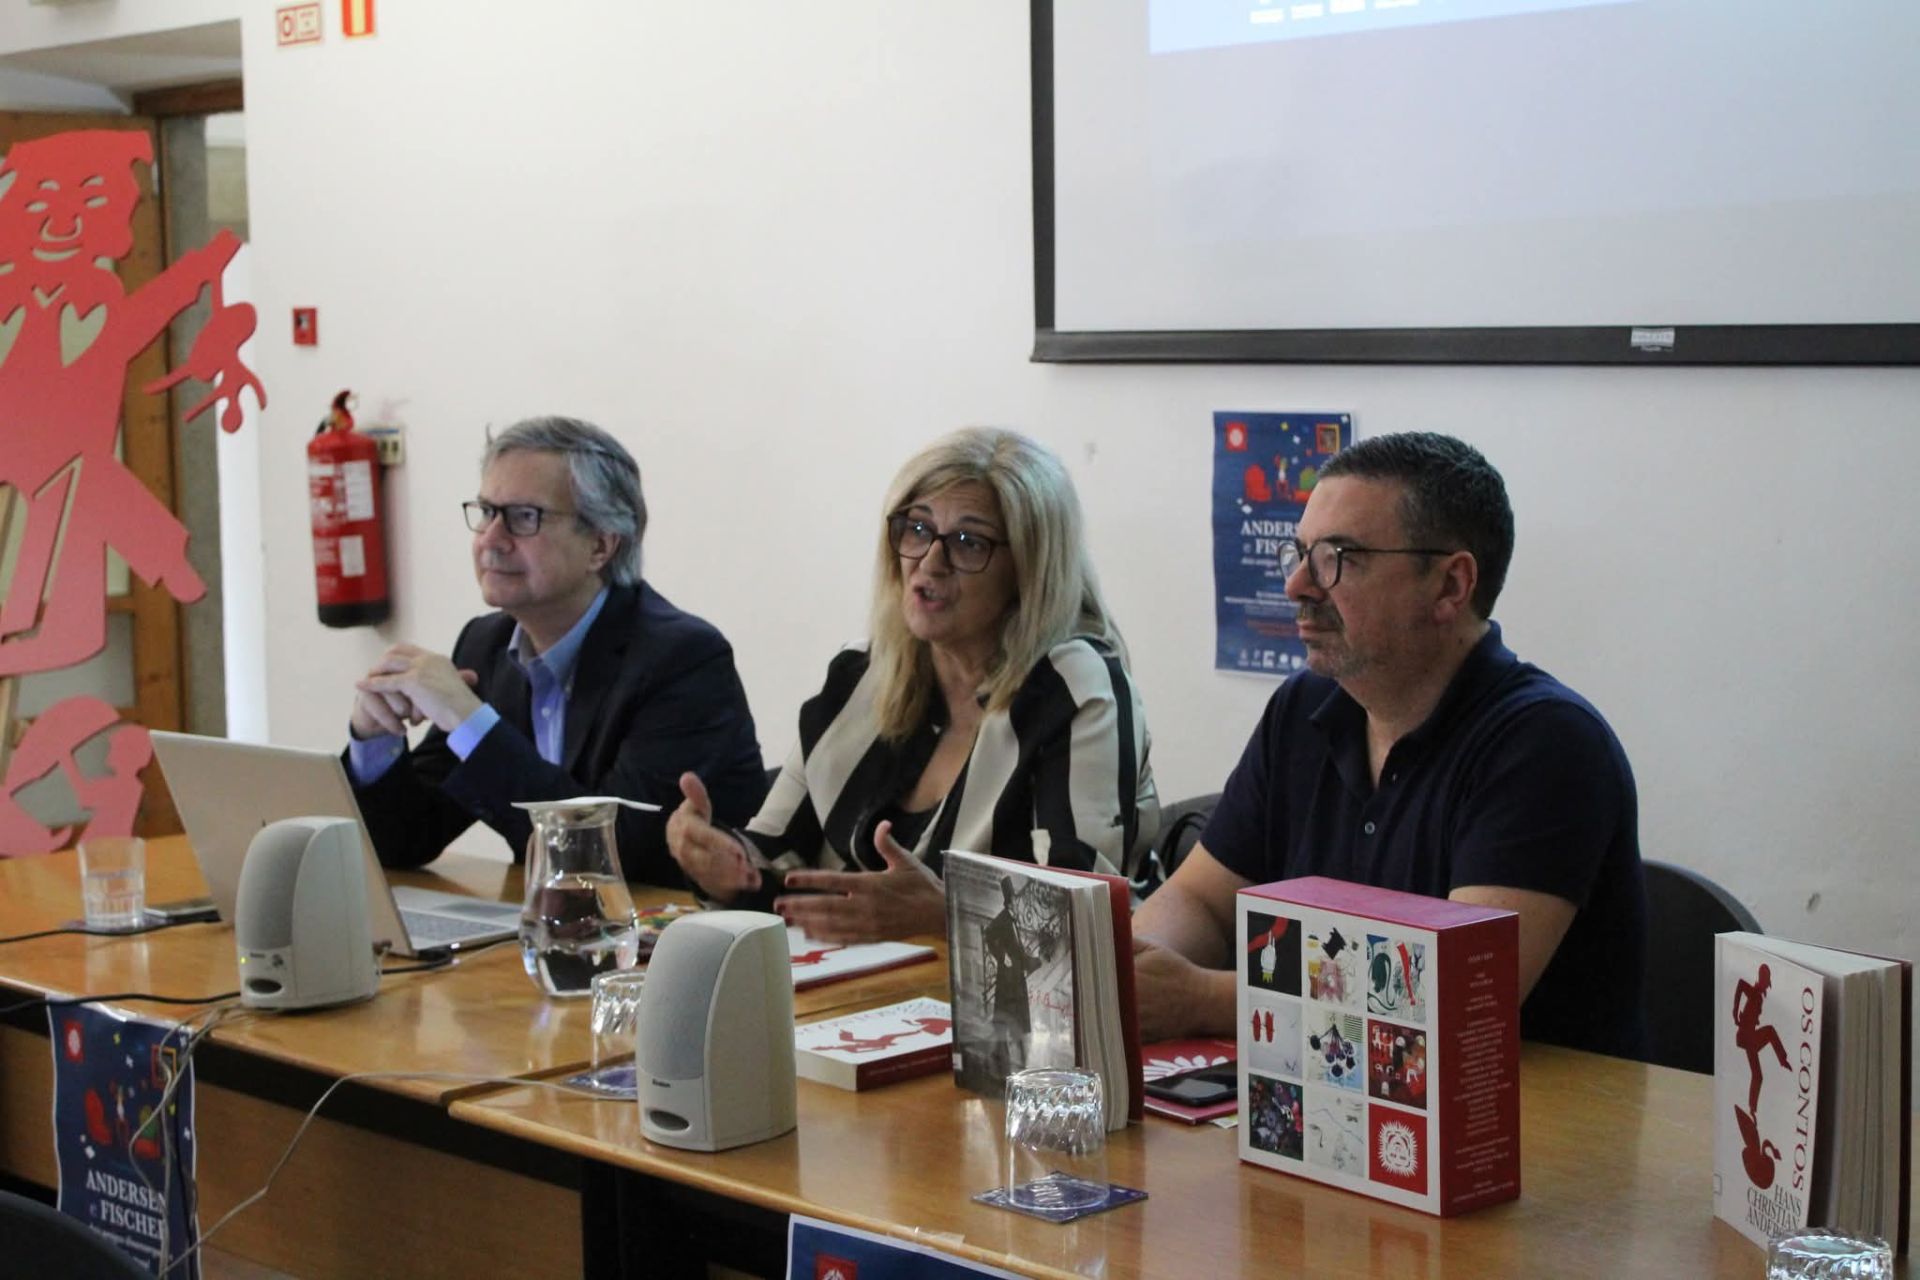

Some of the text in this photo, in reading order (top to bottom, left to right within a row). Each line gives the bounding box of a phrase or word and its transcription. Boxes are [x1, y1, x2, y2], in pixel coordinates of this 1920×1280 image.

[1792, 986, 1815, 1190] OS CONTOS
[1775, 1184, 1801, 1217] HANS
